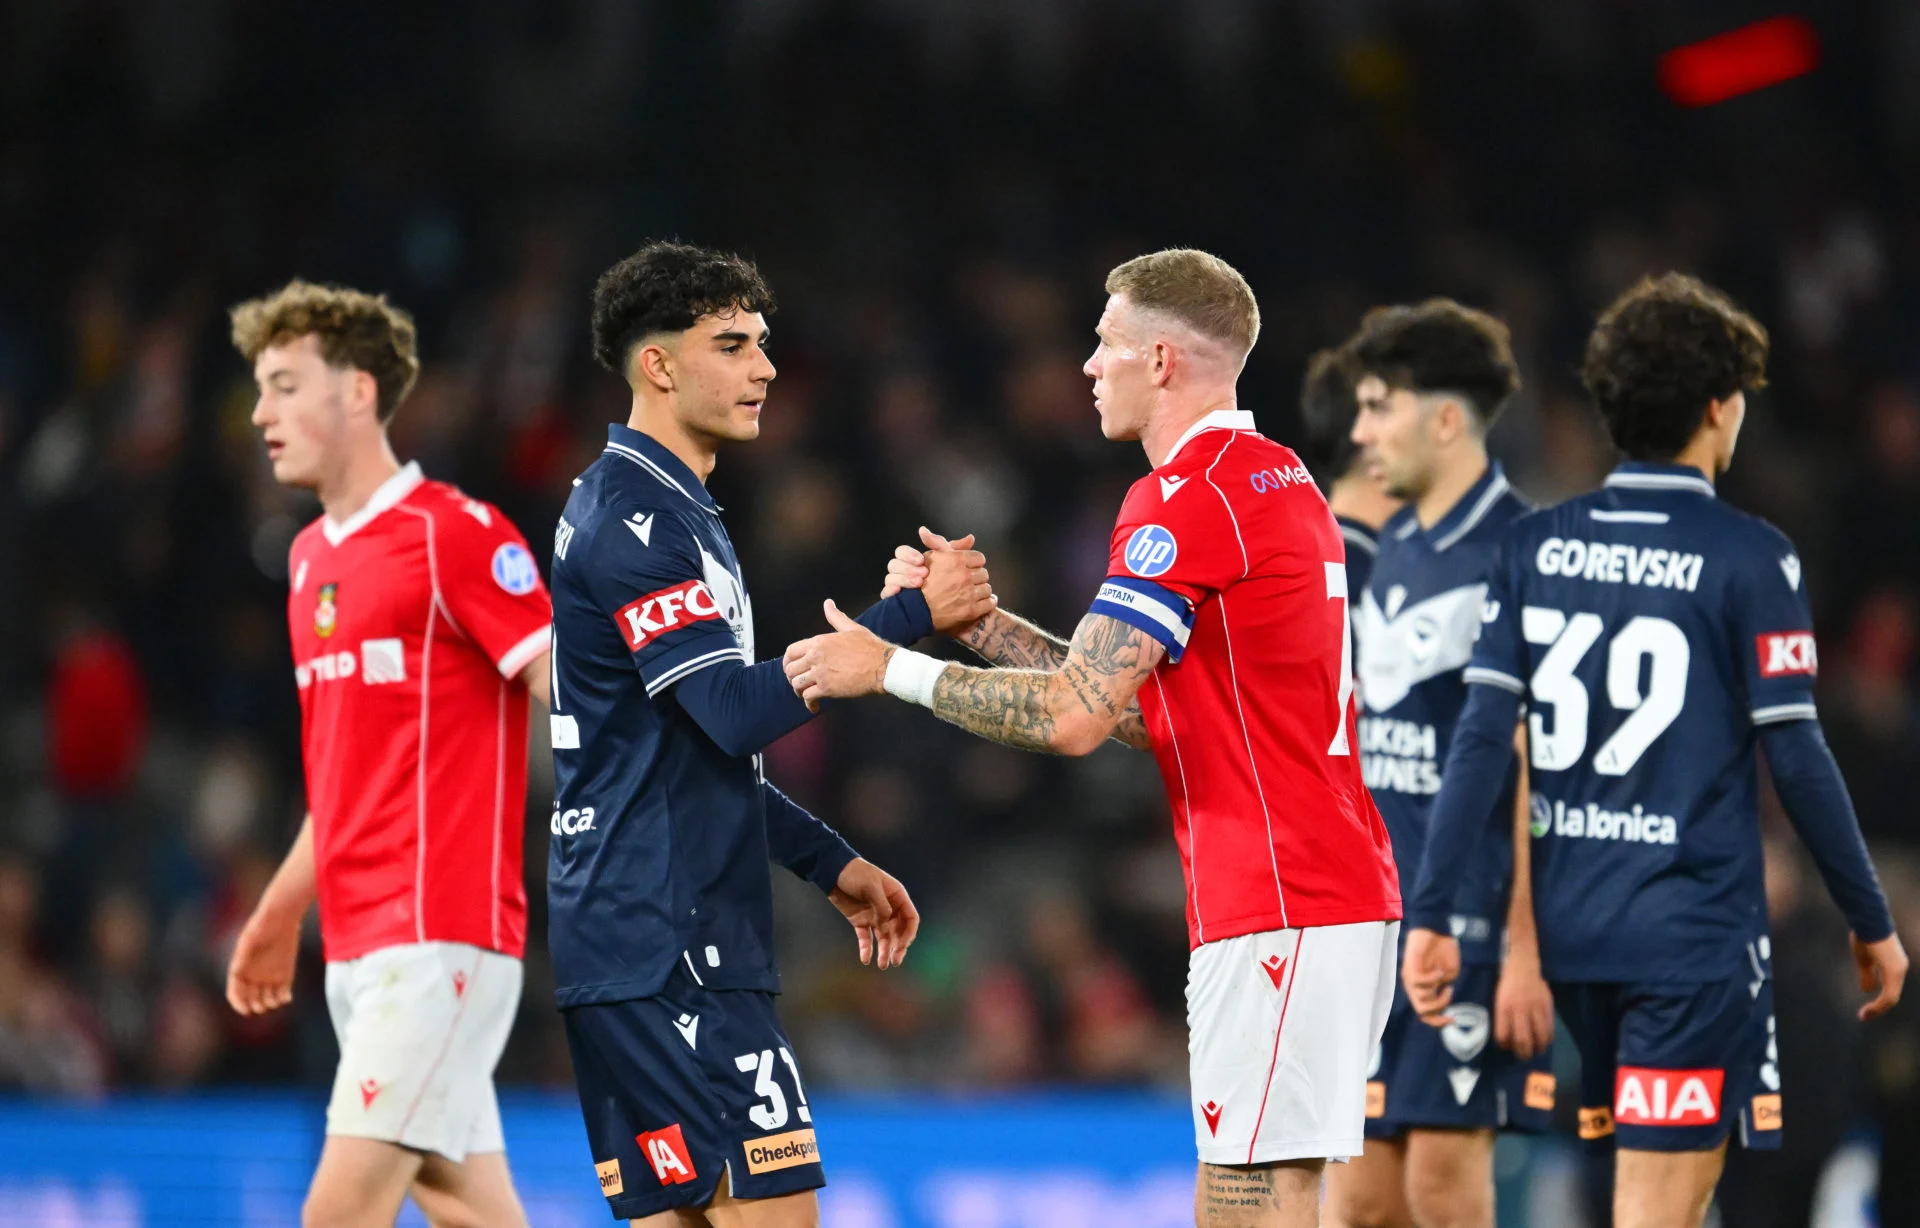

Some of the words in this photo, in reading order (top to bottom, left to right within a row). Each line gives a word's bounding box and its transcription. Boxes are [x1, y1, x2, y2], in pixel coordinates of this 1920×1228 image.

[1128, 524, 1176, 577] hp
[1536, 537, 1704, 592] GOREVSKI
[624, 578, 722, 646] KFC
[1522, 605, 1691, 777] 39
[1617, 1077, 1715, 1120] AIA
